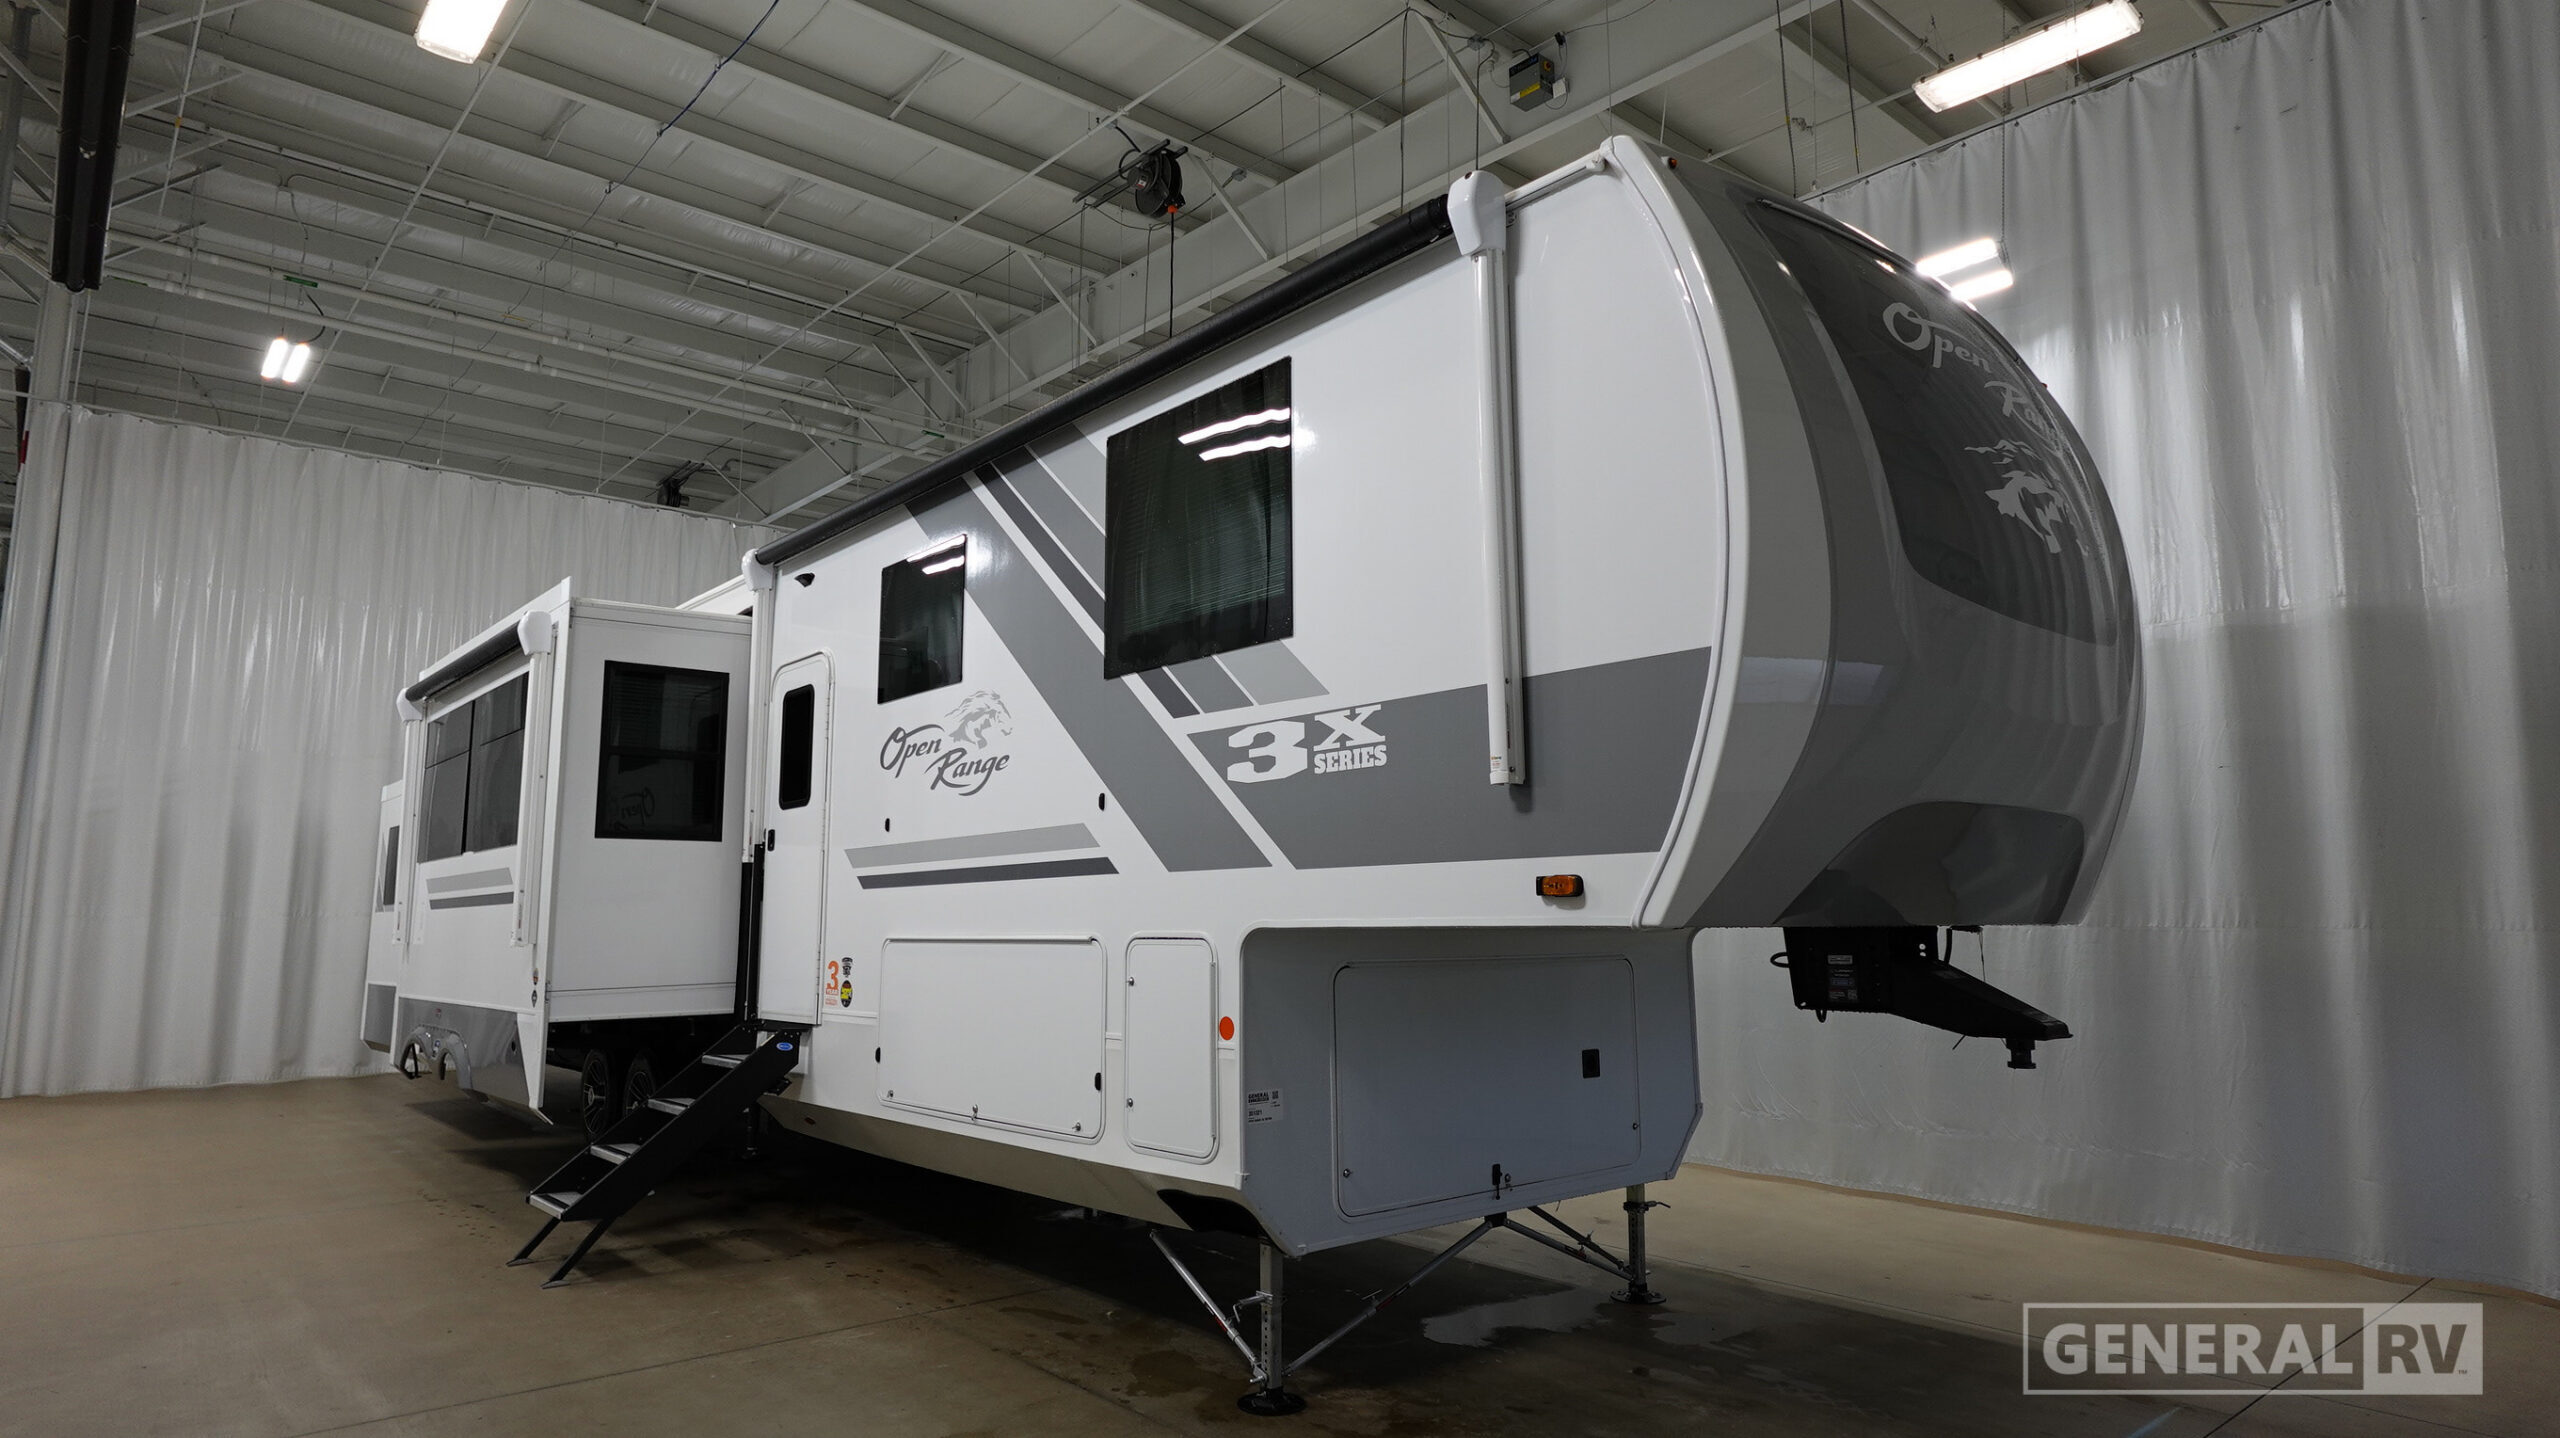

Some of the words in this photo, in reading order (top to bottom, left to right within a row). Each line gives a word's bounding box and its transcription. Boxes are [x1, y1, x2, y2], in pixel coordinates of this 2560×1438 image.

[1882, 302, 1993, 373] Open
[880, 724, 945, 778] Open
[924, 747, 1010, 796] Range
[1313, 744, 1388, 774] SERIES
[827, 960, 839, 990] 3
